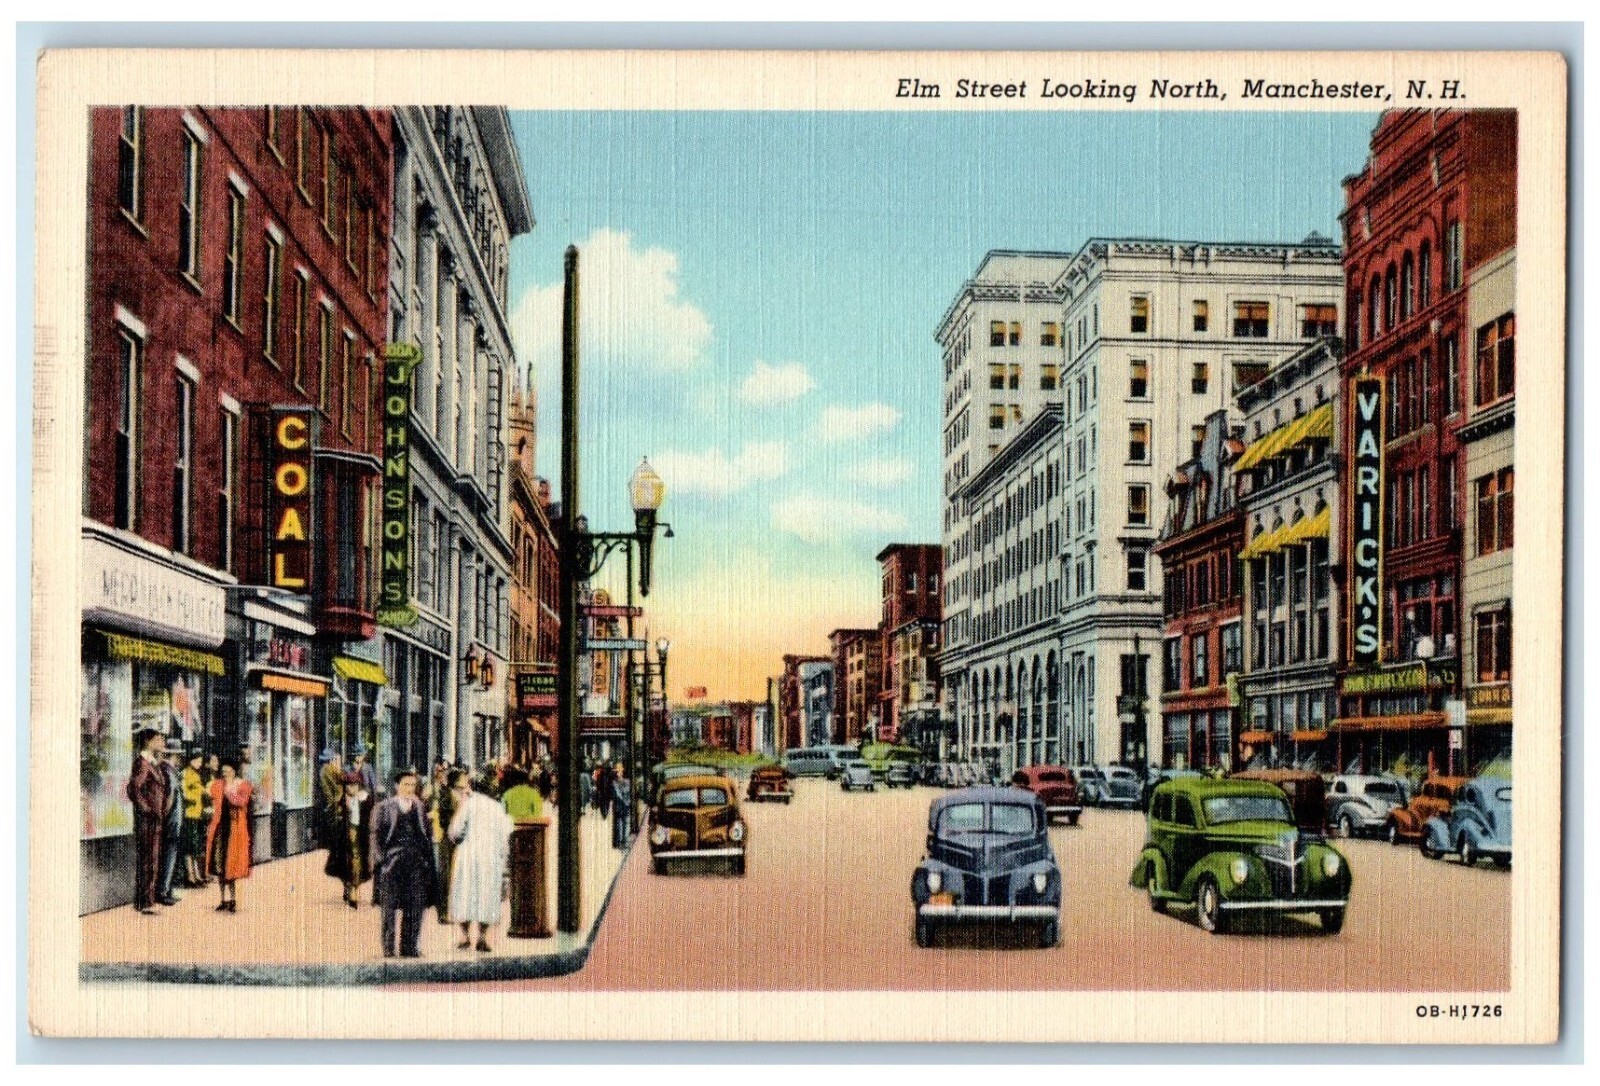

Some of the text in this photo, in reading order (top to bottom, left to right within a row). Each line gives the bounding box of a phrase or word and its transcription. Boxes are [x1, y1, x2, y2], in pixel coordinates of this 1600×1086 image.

[895, 78, 941, 98] Elm
[955, 78, 1027, 98] Street
[1040, 78, 1137, 104] Looking
[1149, 79, 1227, 101] North,
[1241, 79, 1392, 102] Manchester,
[275, 416, 306, 587] COAL
[1356, 391, 1379, 654] VARICK'S
